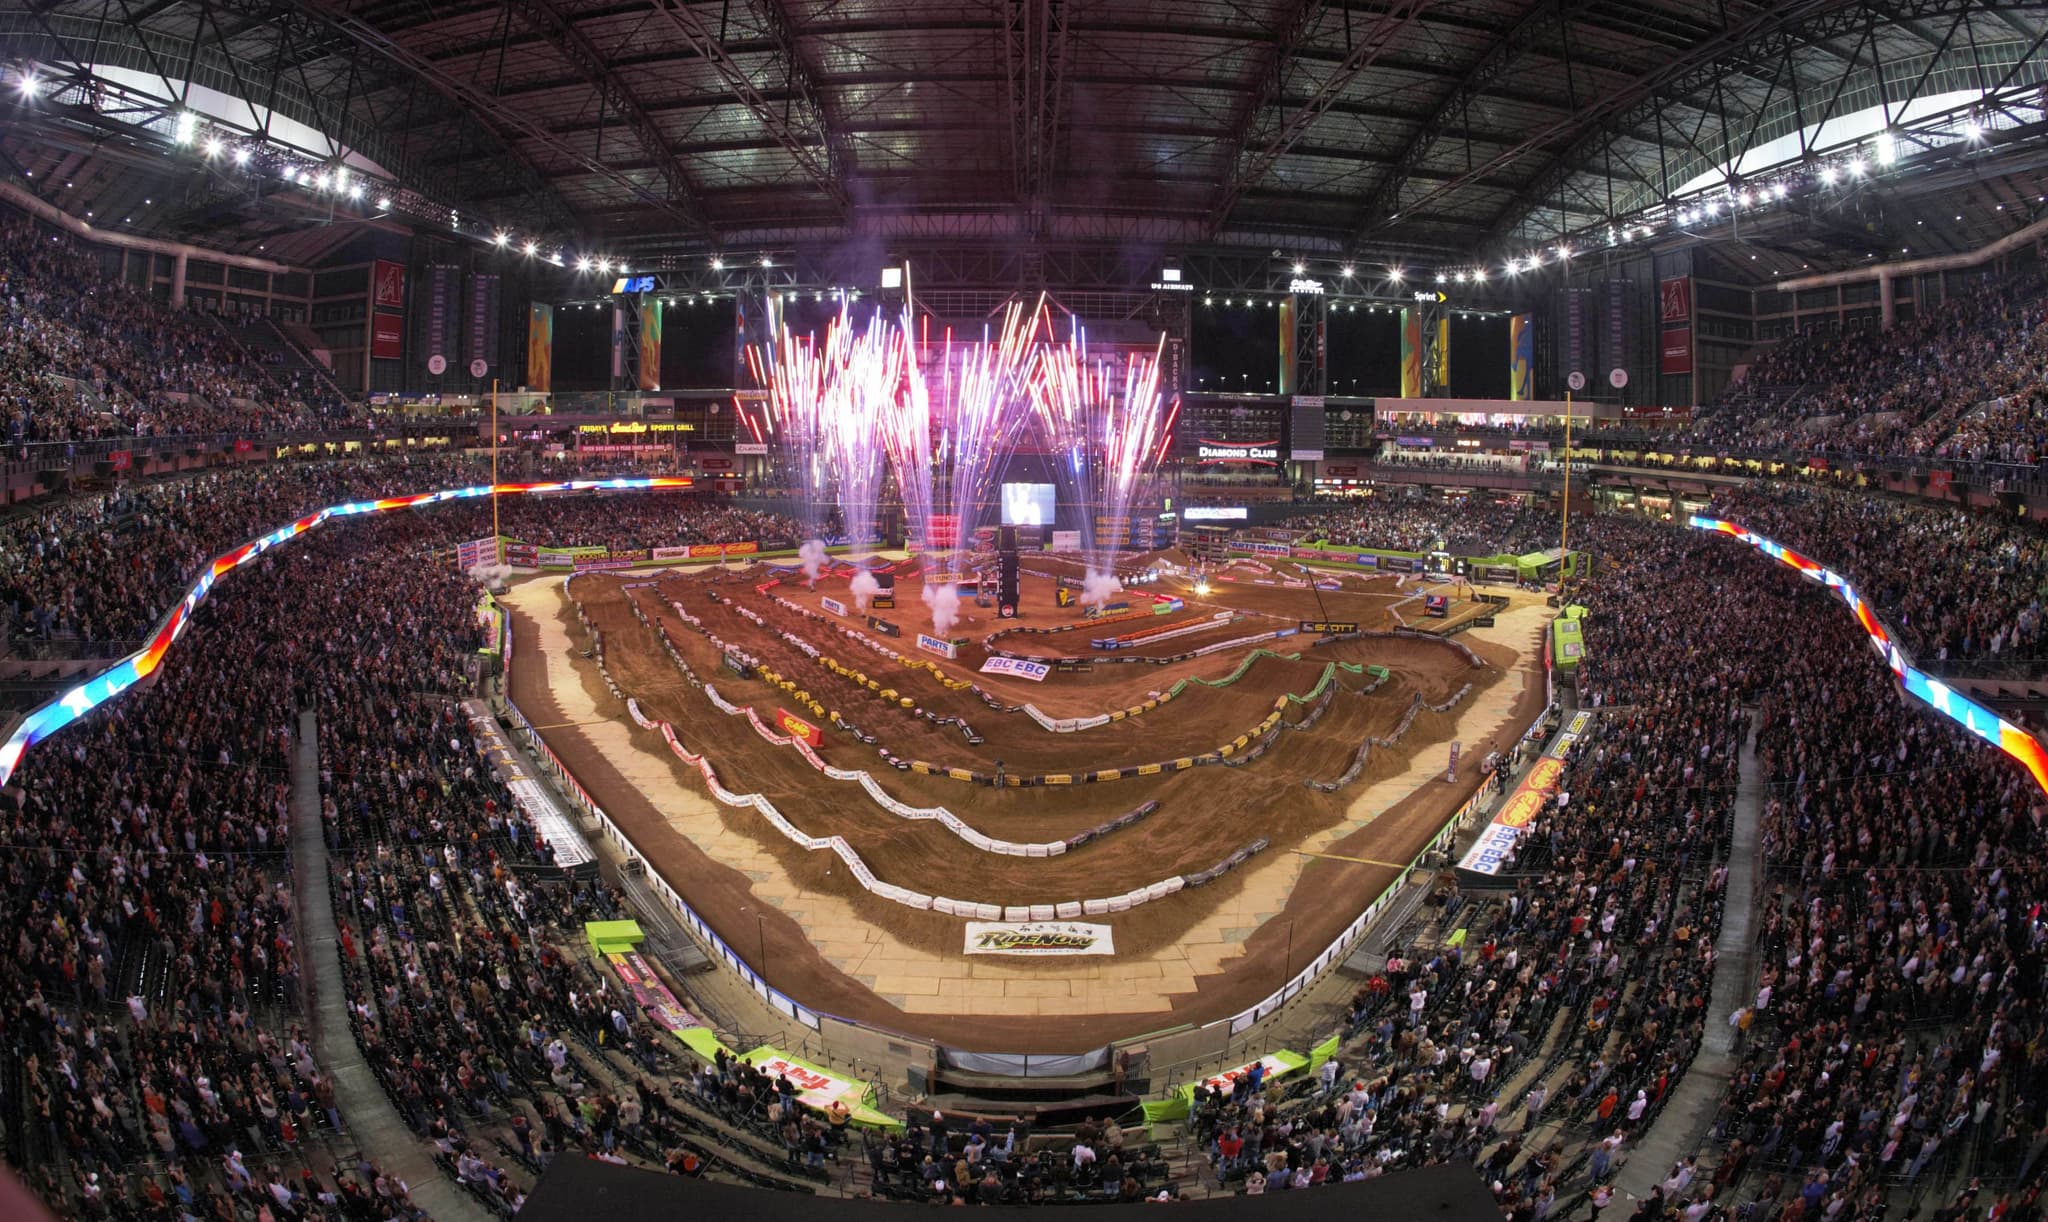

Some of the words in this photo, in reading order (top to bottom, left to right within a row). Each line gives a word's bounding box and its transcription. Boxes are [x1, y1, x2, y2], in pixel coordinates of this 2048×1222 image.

[623, 276, 656, 293] APS
[1414, 291, 1437, 302] Sprint
[1199, 447, 1247, 458] DIAMOND
[1249, 447, 1278, 458] CLUB
[921, 636, 948, 651] PARTS
[985, 658, 1013, 668] EBC
[1015, 661, 1047, 675] EBC
[1473, 848, 1503, 872] EBC
